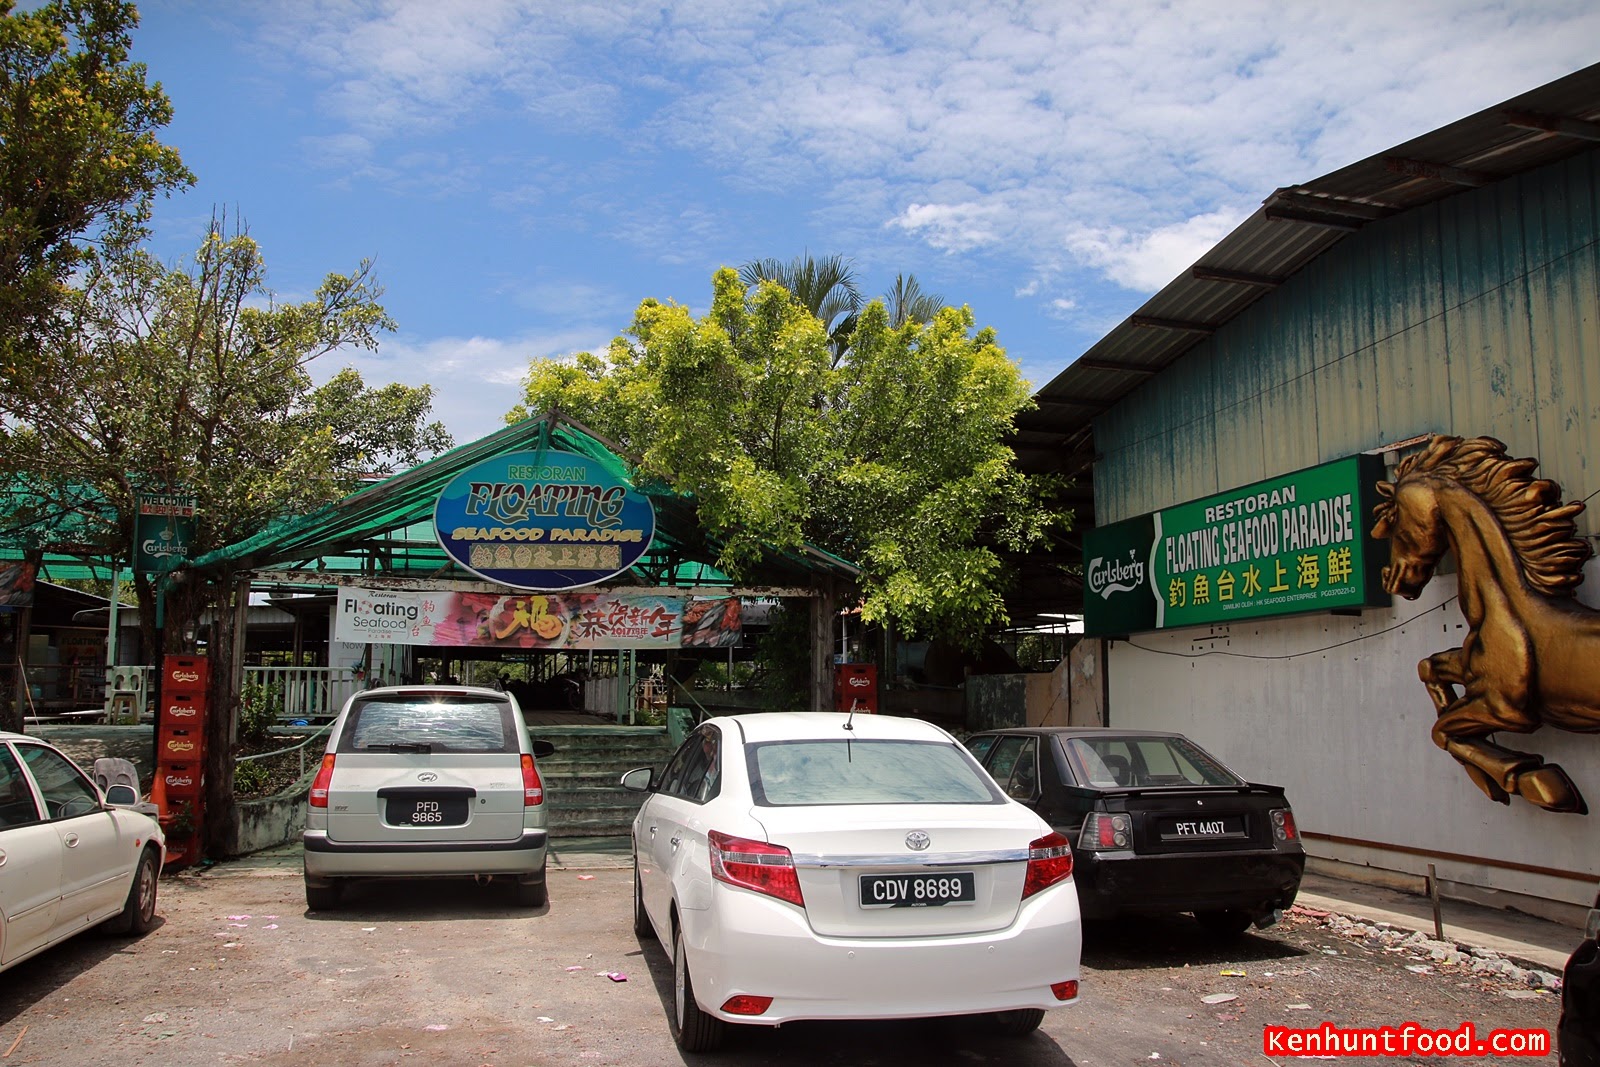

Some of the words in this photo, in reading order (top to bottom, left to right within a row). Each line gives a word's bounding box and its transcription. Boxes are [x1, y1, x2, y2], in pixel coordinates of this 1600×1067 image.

[508, 465, 585, 480] RESTORAN
[142, 496, 193, 507] WELCOME
[1205, 485, 1296, 523] RESTORAN
[451, 527, 544, 541] SEAFOOD
[549, 528, 643, 542] PARADISE
[1166, 526, 1220, 574] FLOATING
[1223, 508, 1279, 565] SEAFOOD
[1282, 494, 1353, 552] PARADISE
[142, 539, 188, 556] Carlsberg
[1088, 556, 1144, 593] Carlsberg
[1168, 547, 1353, 608] 釣魚台水上海鮮
[368, 590, 397, 598] Restoran
[1264, 596, 1286, 605] SEAFOOD
[1286, 591, 1317, 602] ENTERPRISE
[353, 616, 407, 629] Seafood
[172, 671, 199, 682] Carlsberg
[849, 677, 870, 687] Carlsberg
[170, 706, 196, 717] Carlsberg
[167, 740, 194, 752] Carlsberg
[166, 776, 192, 787] Carlsberg
[416, 802, 439, 812] PFD
[412, 812, 442, 823] 9865
[1176, 823, 1197, 836] PFT
[1199, 821, 1225, 834] 4407
[873, 880, 909, 900] CDV
[913, 878, 962, 898] 8689
